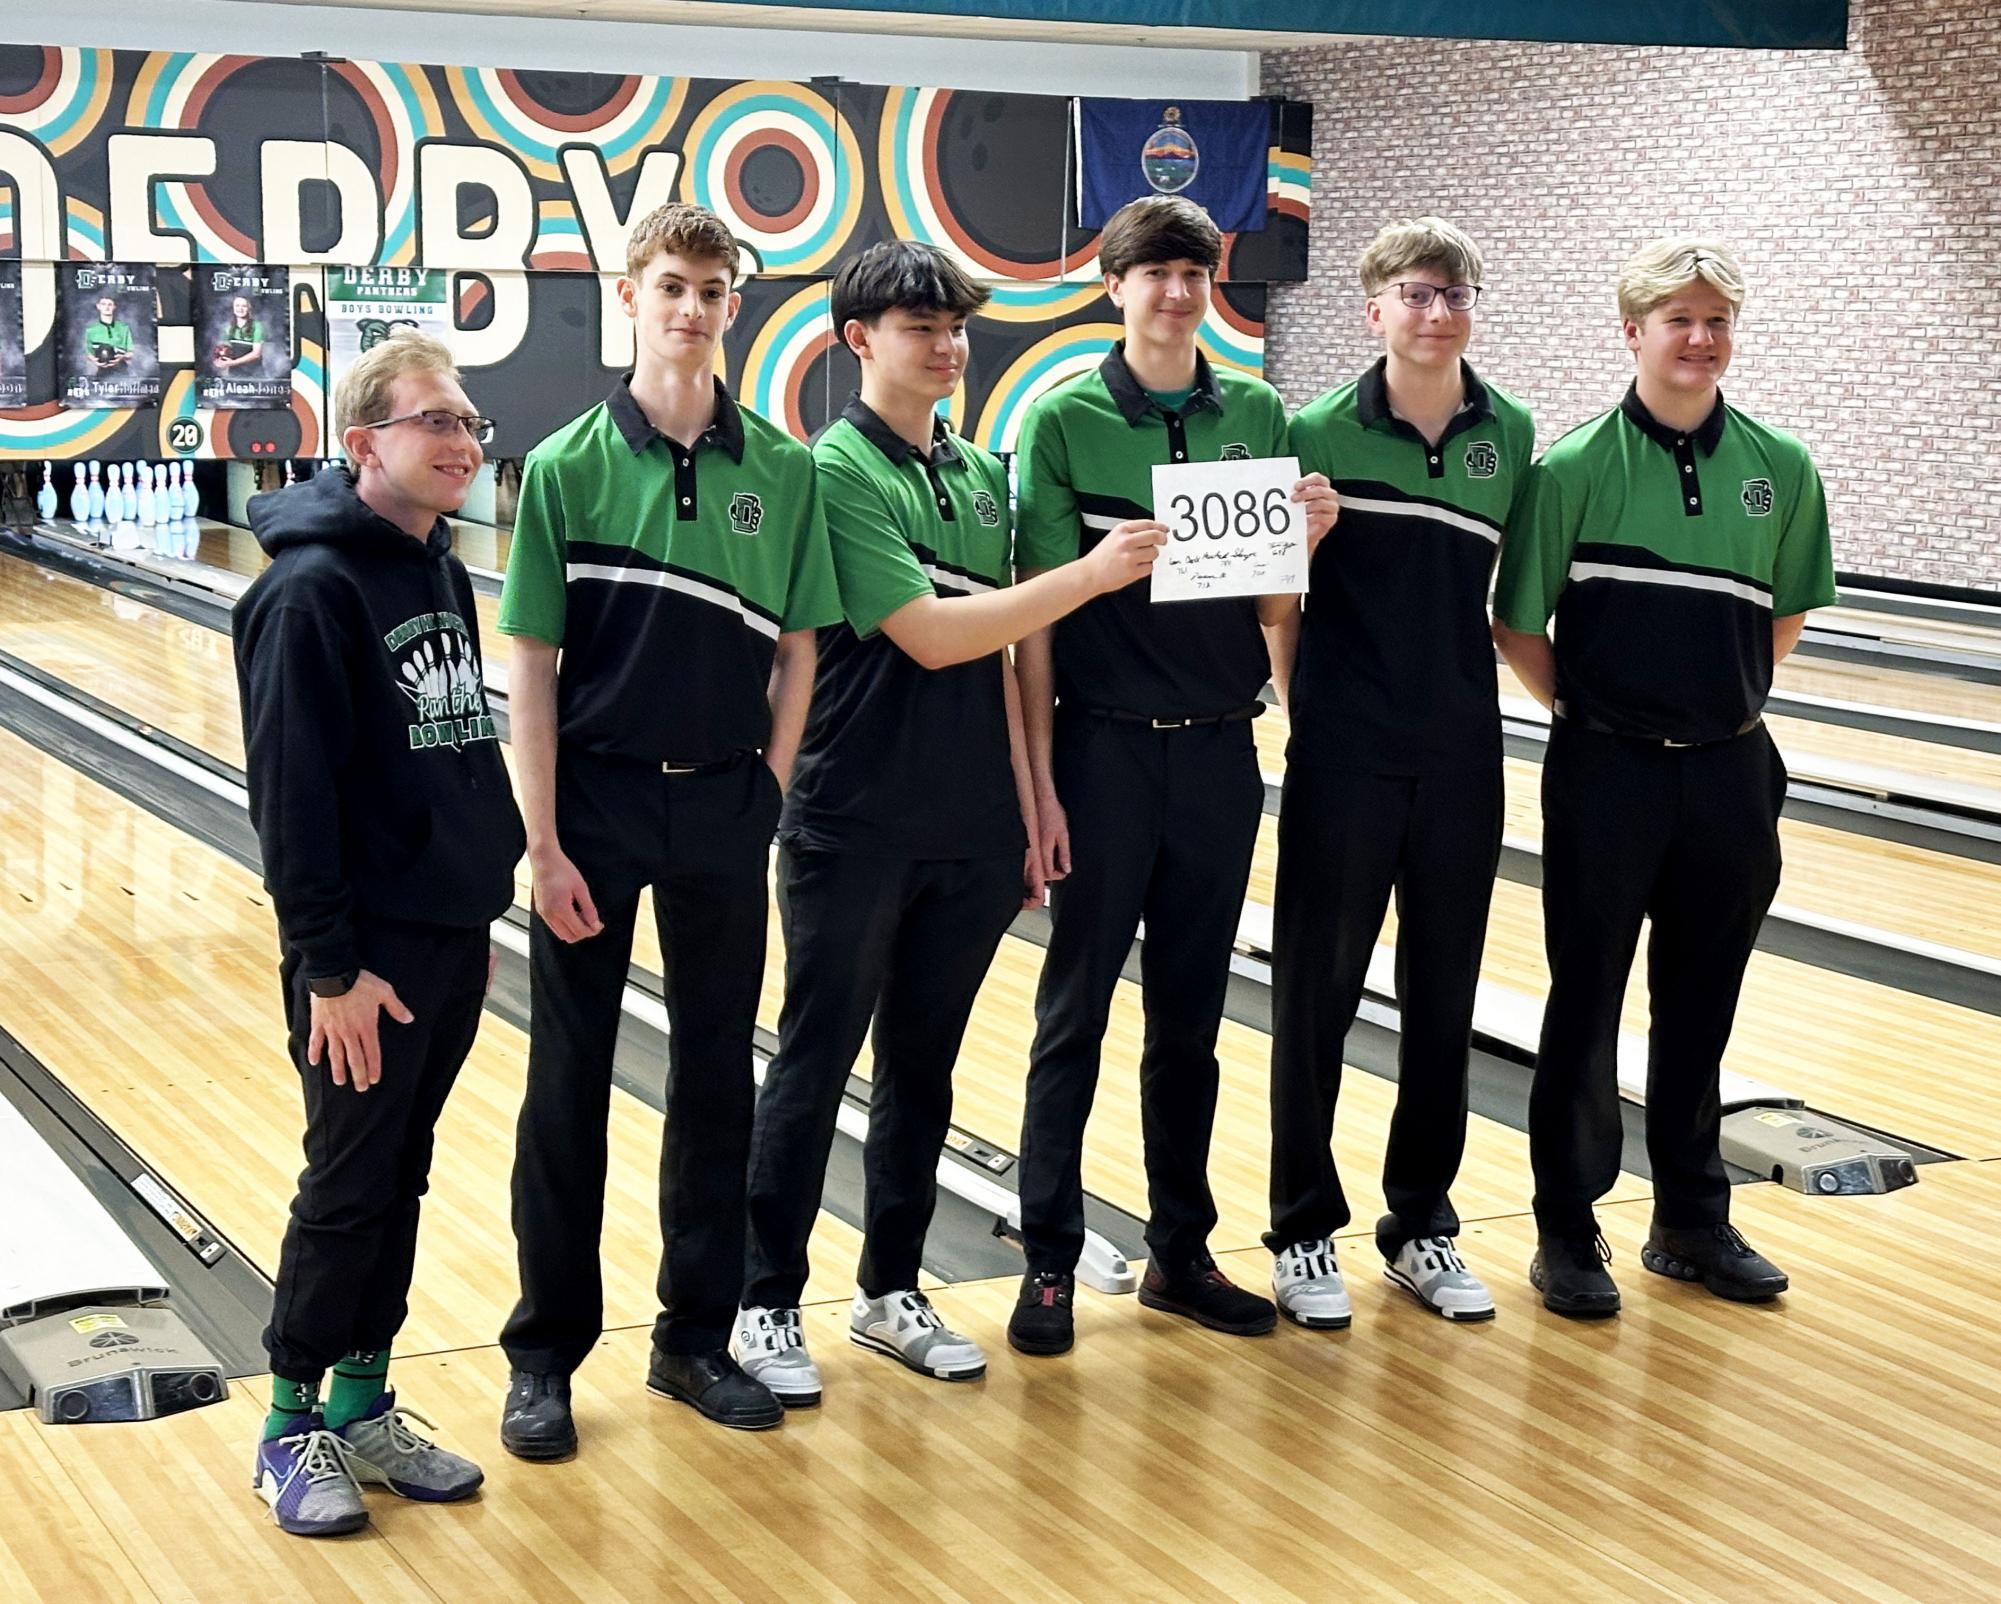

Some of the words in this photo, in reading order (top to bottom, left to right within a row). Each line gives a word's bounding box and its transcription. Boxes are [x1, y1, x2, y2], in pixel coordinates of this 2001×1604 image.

[343, 267, 429, 286] DERBY
[356, 286, 418, 296] PANTHERS
[341, 304, 372, 313] BOYS
[378, 305, 433, 315] BOWLING
[92, 381, 118, 395] Tyler
[226, 382, 255, 394] Aleah
[172, 424, 198, 447] 20
[1170, 487, 1290, 542] 3086
[67, 1347, 179, 1368] Brunswick
